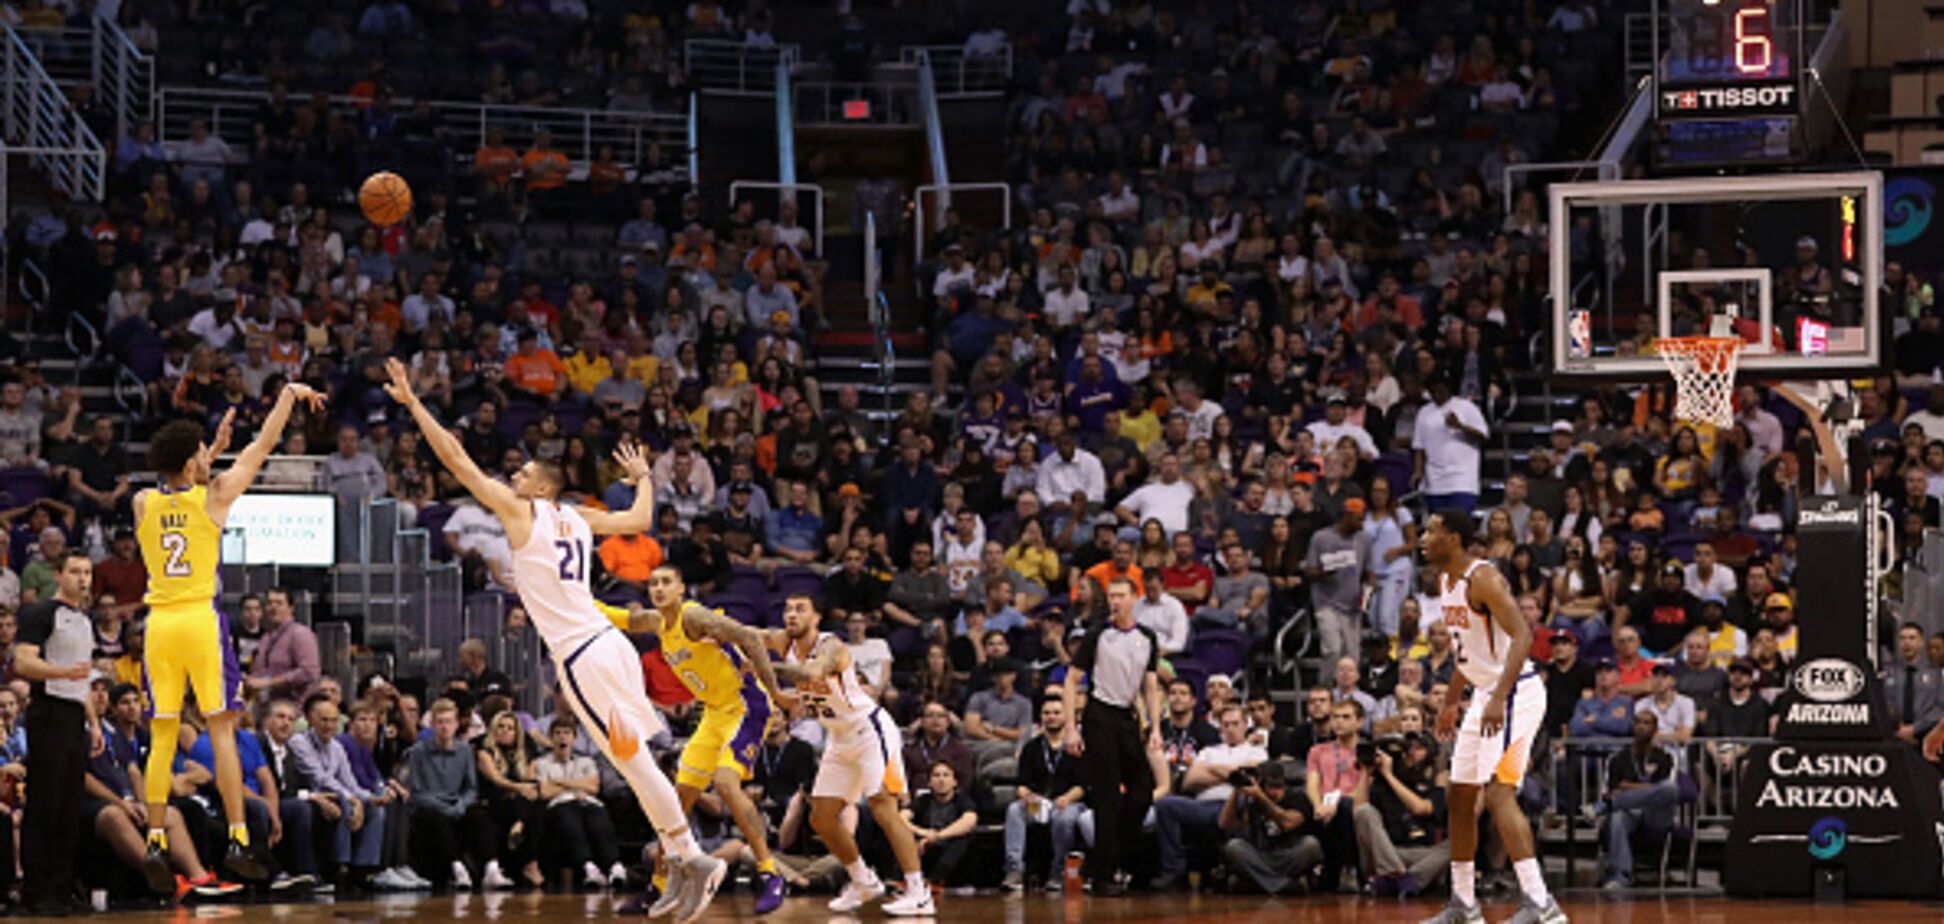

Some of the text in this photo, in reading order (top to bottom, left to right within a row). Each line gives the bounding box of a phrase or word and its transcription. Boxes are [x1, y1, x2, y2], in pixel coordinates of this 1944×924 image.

[1735, 8, 1771, 73] 6
[1700, 86, 1794, 108] TISSOT
[160, 530, 192, 577] 2
[554, 538, 585, 583] 21
[1810, 668, 1848, 685] FOX
[1786, 703, 1870, 725] ARIZONA
[1769, 747, 1888, 776] CASINO
[1755, 779, 1899, 808] ARIZONA
